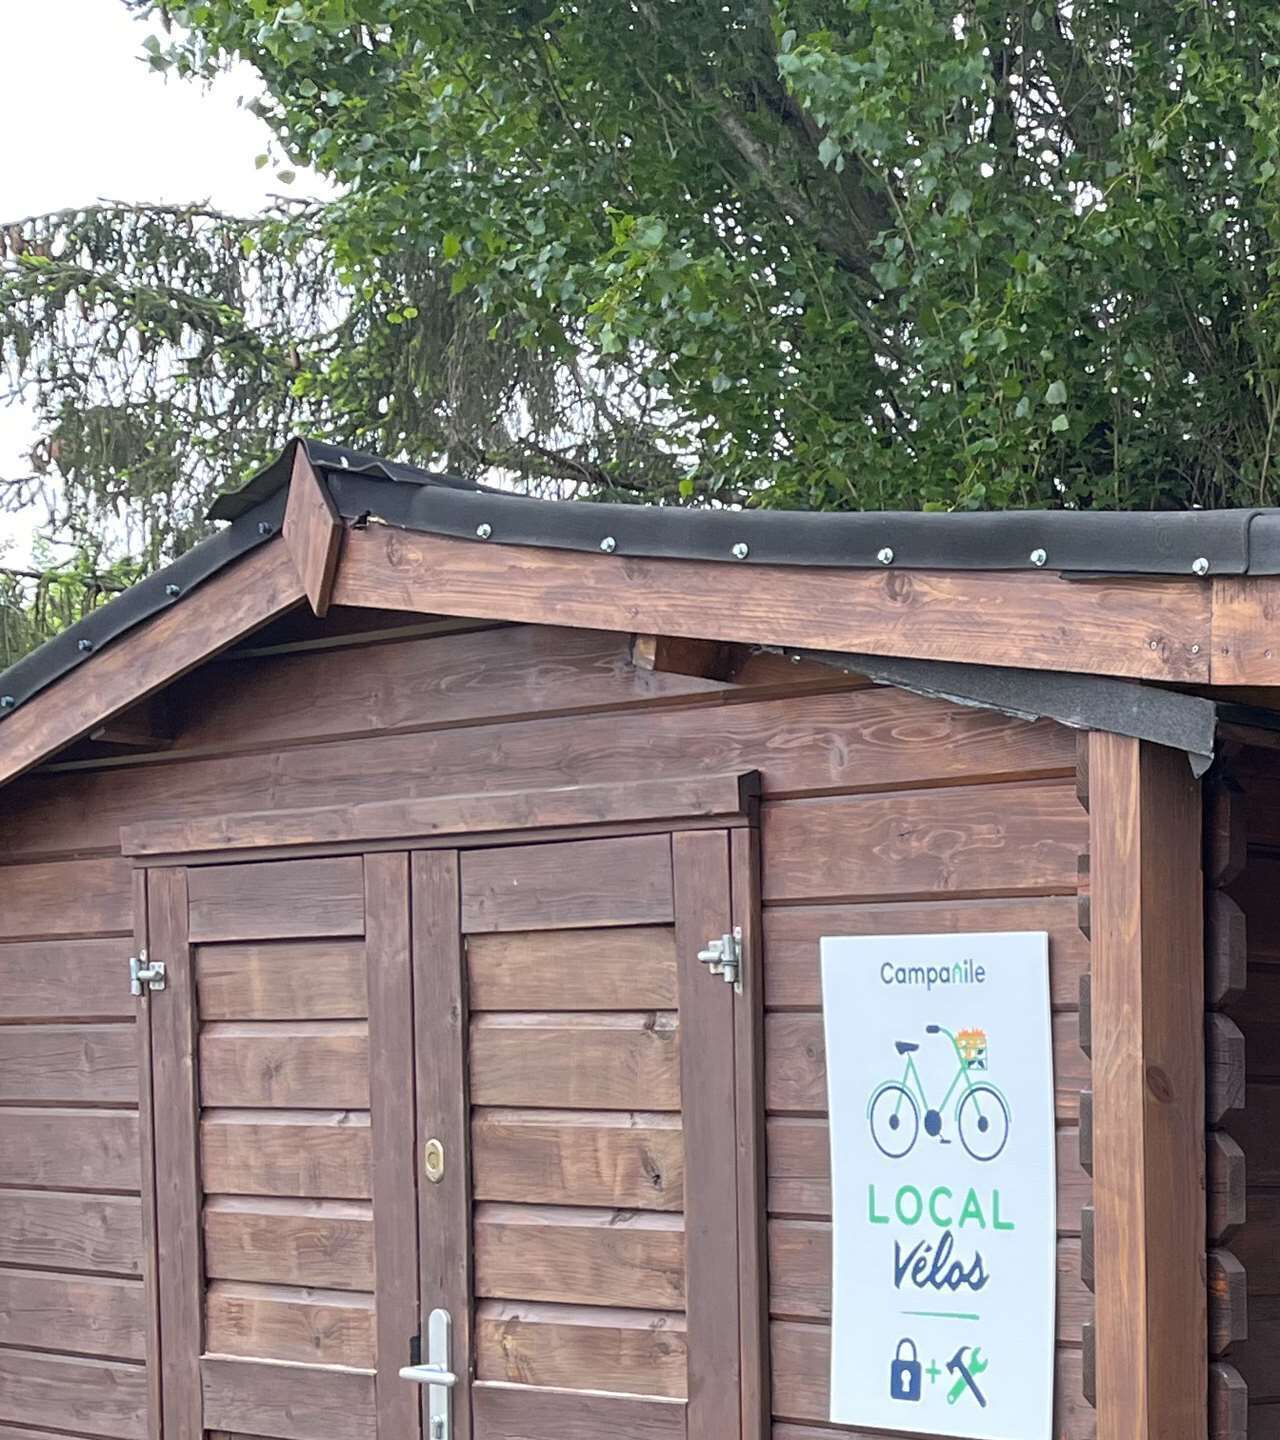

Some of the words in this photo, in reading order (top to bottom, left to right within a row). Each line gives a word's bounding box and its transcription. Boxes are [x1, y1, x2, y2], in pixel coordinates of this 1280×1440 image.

[880, 959, 985, 991] Campanile
[868, 1183, 1015, 1230] LOCAL
[894, 1229, 990, 1291] Vélos
